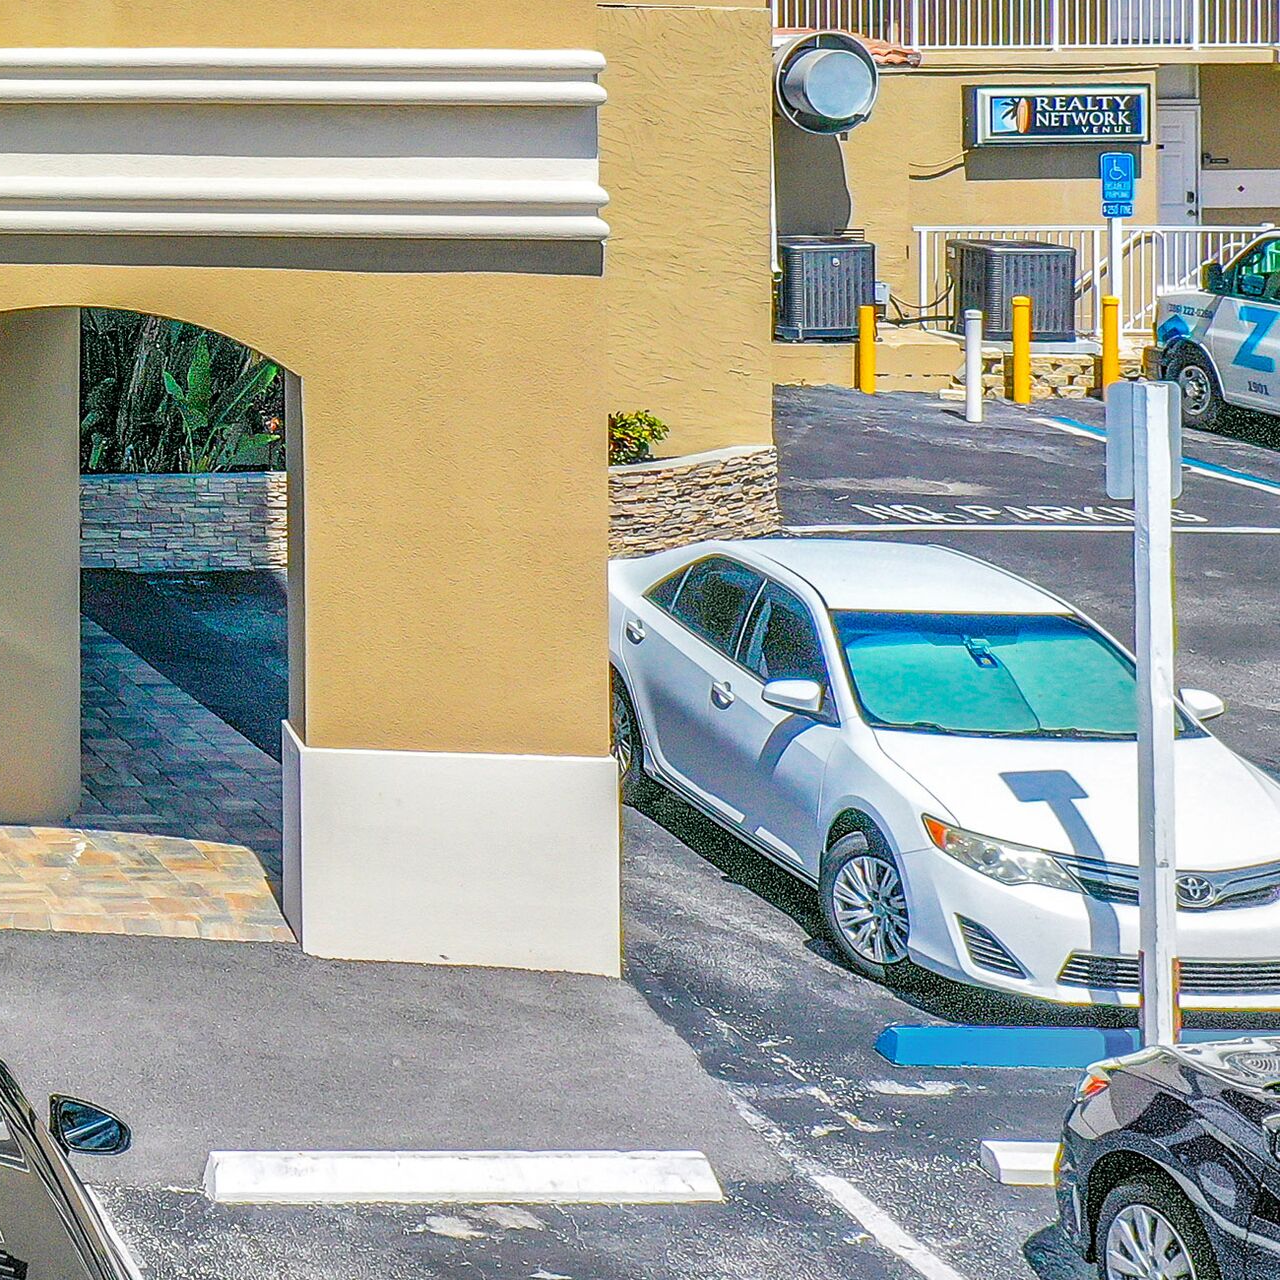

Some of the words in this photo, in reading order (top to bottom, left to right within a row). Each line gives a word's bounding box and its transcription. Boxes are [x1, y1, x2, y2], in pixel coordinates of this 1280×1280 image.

[1035, 96, 1131, 111] REALTY
[1035, 111, 1131, 126] NETWORK
[1081, 126, 1131, 134] VENUE
[954, 504, 1209, 522] PARKIG
